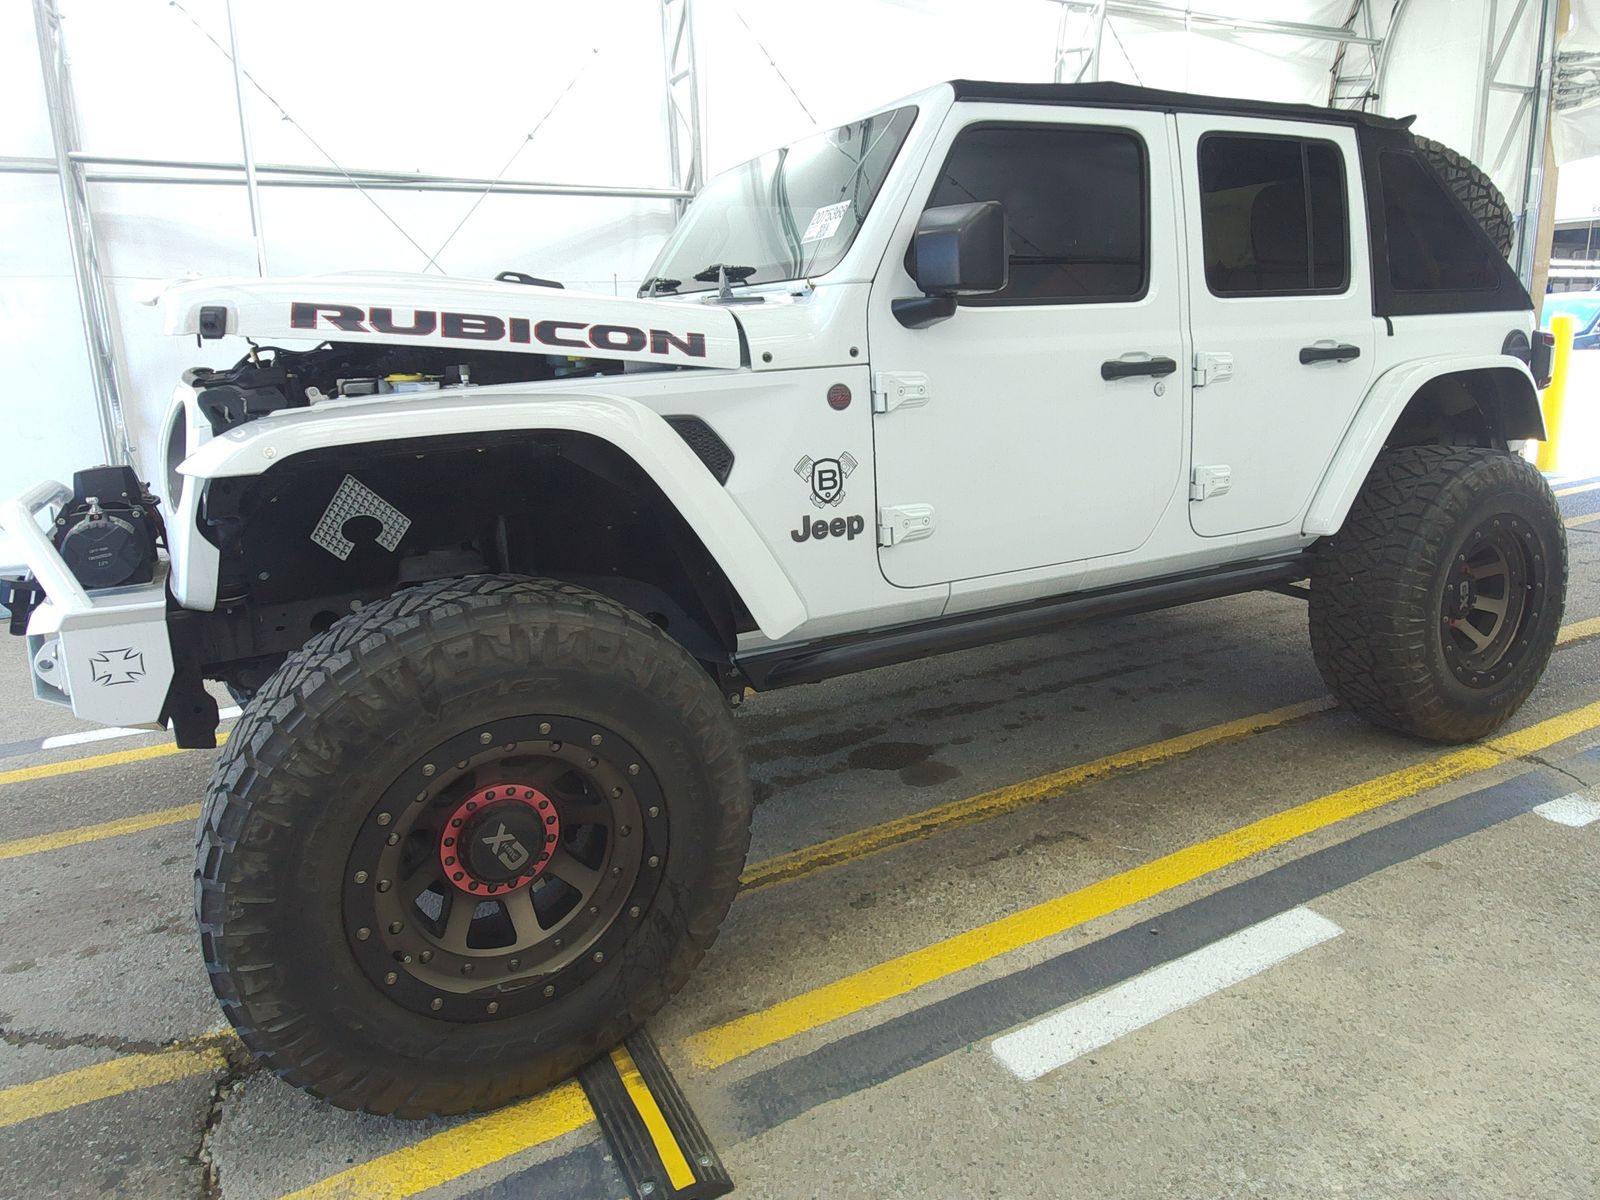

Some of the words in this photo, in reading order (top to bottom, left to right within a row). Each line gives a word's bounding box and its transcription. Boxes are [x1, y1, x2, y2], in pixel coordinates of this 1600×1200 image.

[290, 302, 706, 358] RUBICON
[817, 469, 838, 491] B
[790, 514, 865, 543] Jeep
